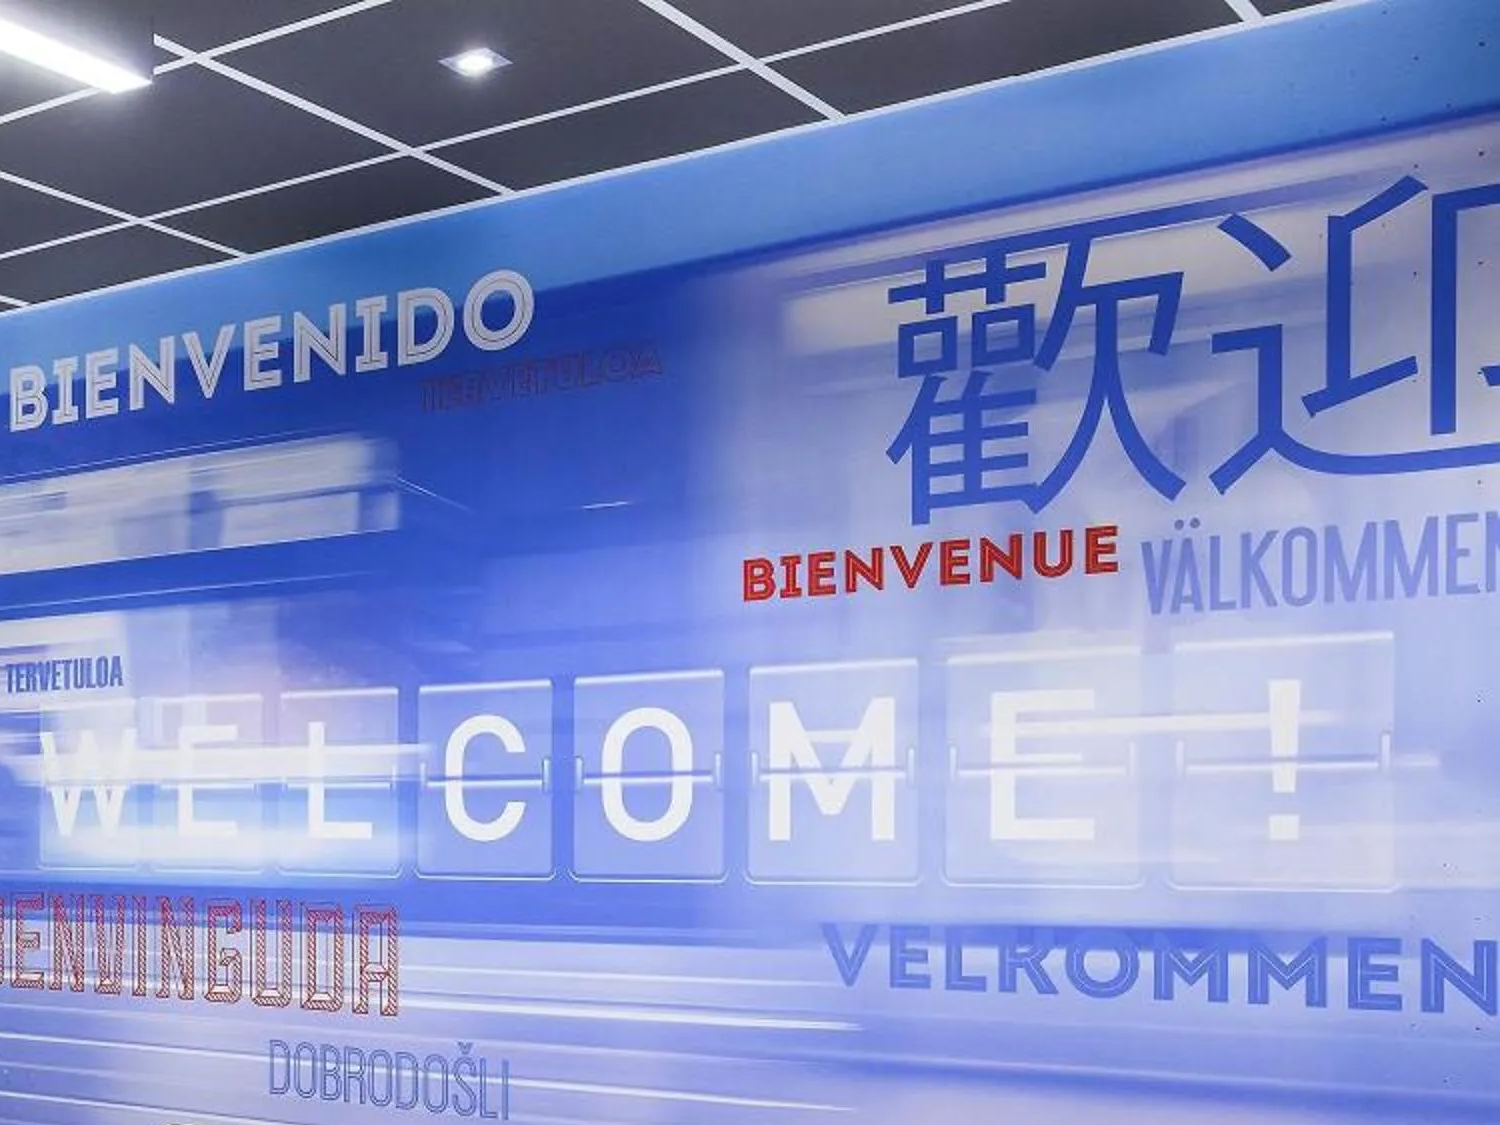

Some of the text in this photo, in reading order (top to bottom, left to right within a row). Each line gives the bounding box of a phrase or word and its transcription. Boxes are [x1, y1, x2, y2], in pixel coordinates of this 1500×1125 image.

[9, 269, 535, 432] BIENVENIDO
[886, 174, 1500, 526] 歡迎
[743, 526, 1120, 602] BIENVENUE
[4, 655, 124, 693] TERVETULOA
[820, 922, 1498, 1017] VELKOMMEN
[269, 1040, 510, 1121] DOBRODOŠLI
